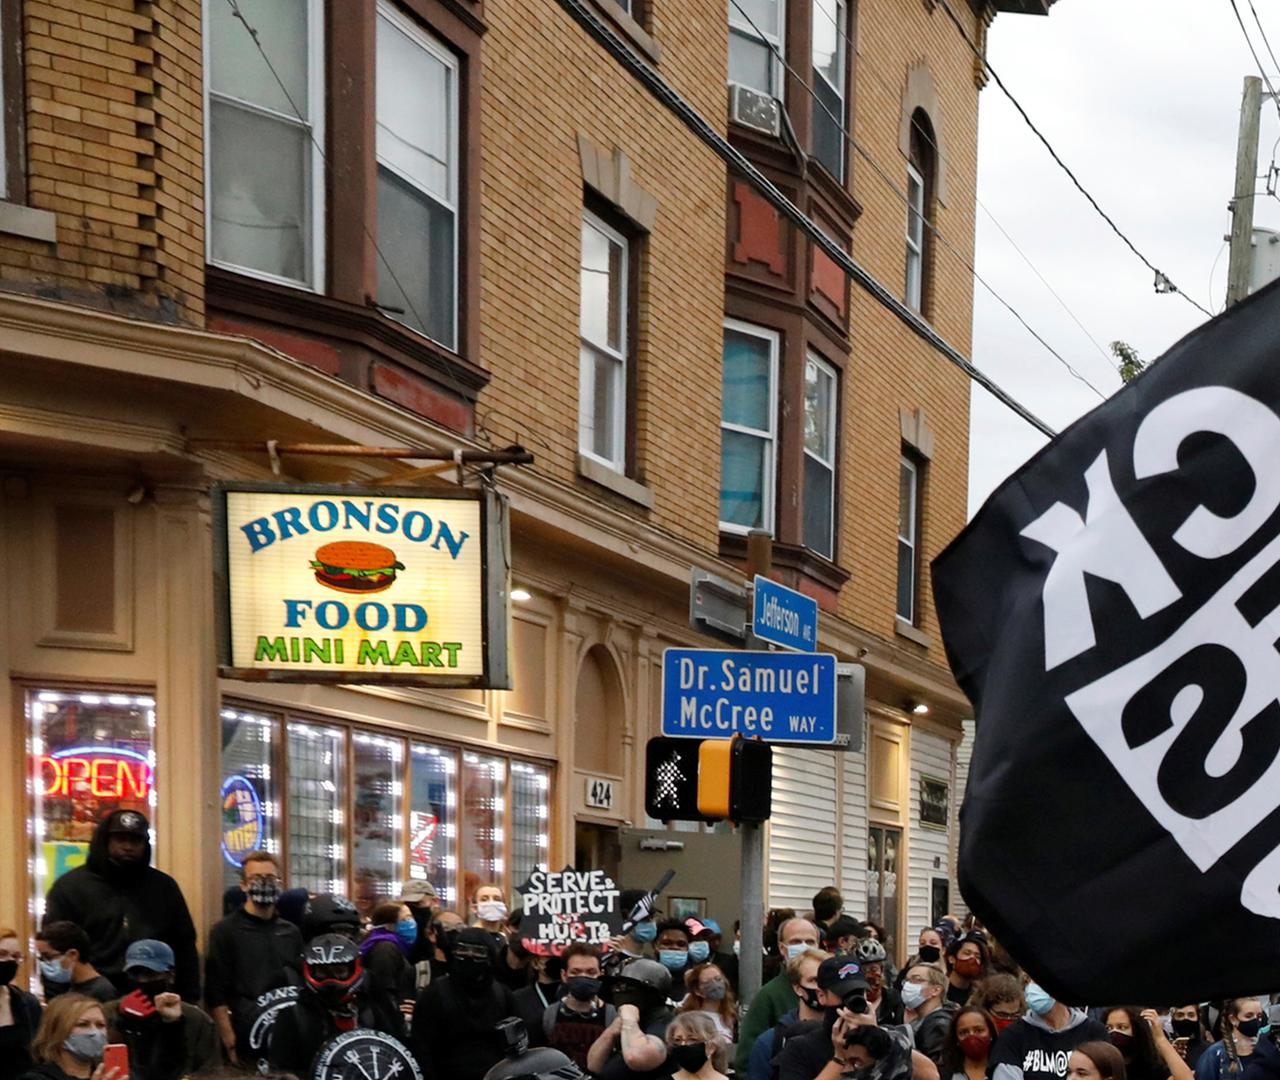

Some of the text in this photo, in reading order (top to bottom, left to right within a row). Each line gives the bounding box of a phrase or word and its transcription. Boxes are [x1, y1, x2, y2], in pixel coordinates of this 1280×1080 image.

[240, 500, 469, 559] BRONSON
[283, 600, 428, 632] FOOD
[760, 594, 799, 637] Jefferson
[254, 635, 462, 668] MINI MART
[721, 660, 818, 694] Samuel
[680, 697, 816, 733] McCree WAY
[38, 757, 147, 797] OPEN
[591, 781, 611, 806] 424
[523, 890, 619, 915] PROTECT
[1023, 1050, 1072, 1077] #BLM@
